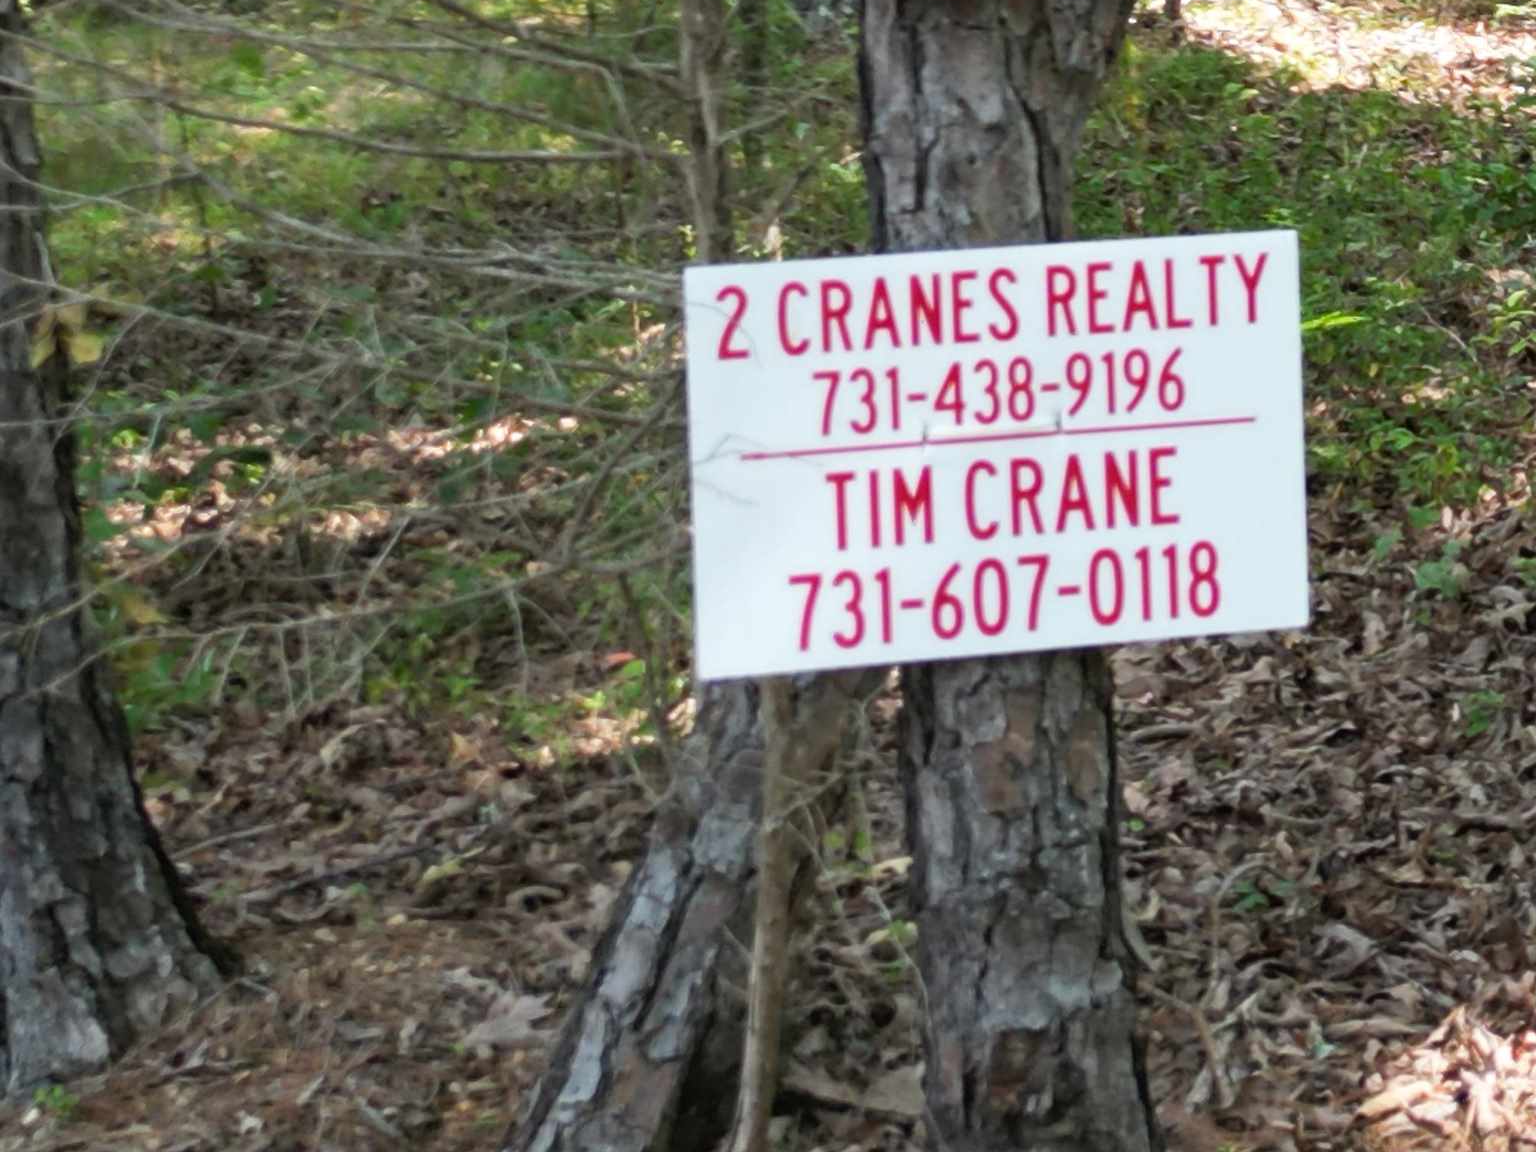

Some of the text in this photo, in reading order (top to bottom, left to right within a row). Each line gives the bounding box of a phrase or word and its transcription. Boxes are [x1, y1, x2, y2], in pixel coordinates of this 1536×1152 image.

[715, 252, 1269, 360] 2 CRANES REALTY
[812, 347, 1185, 436] 731-438-9196
[826, 447, 1181, 551] TIM CRANE
[789, 540, 1221, 651] 731-607-0118
